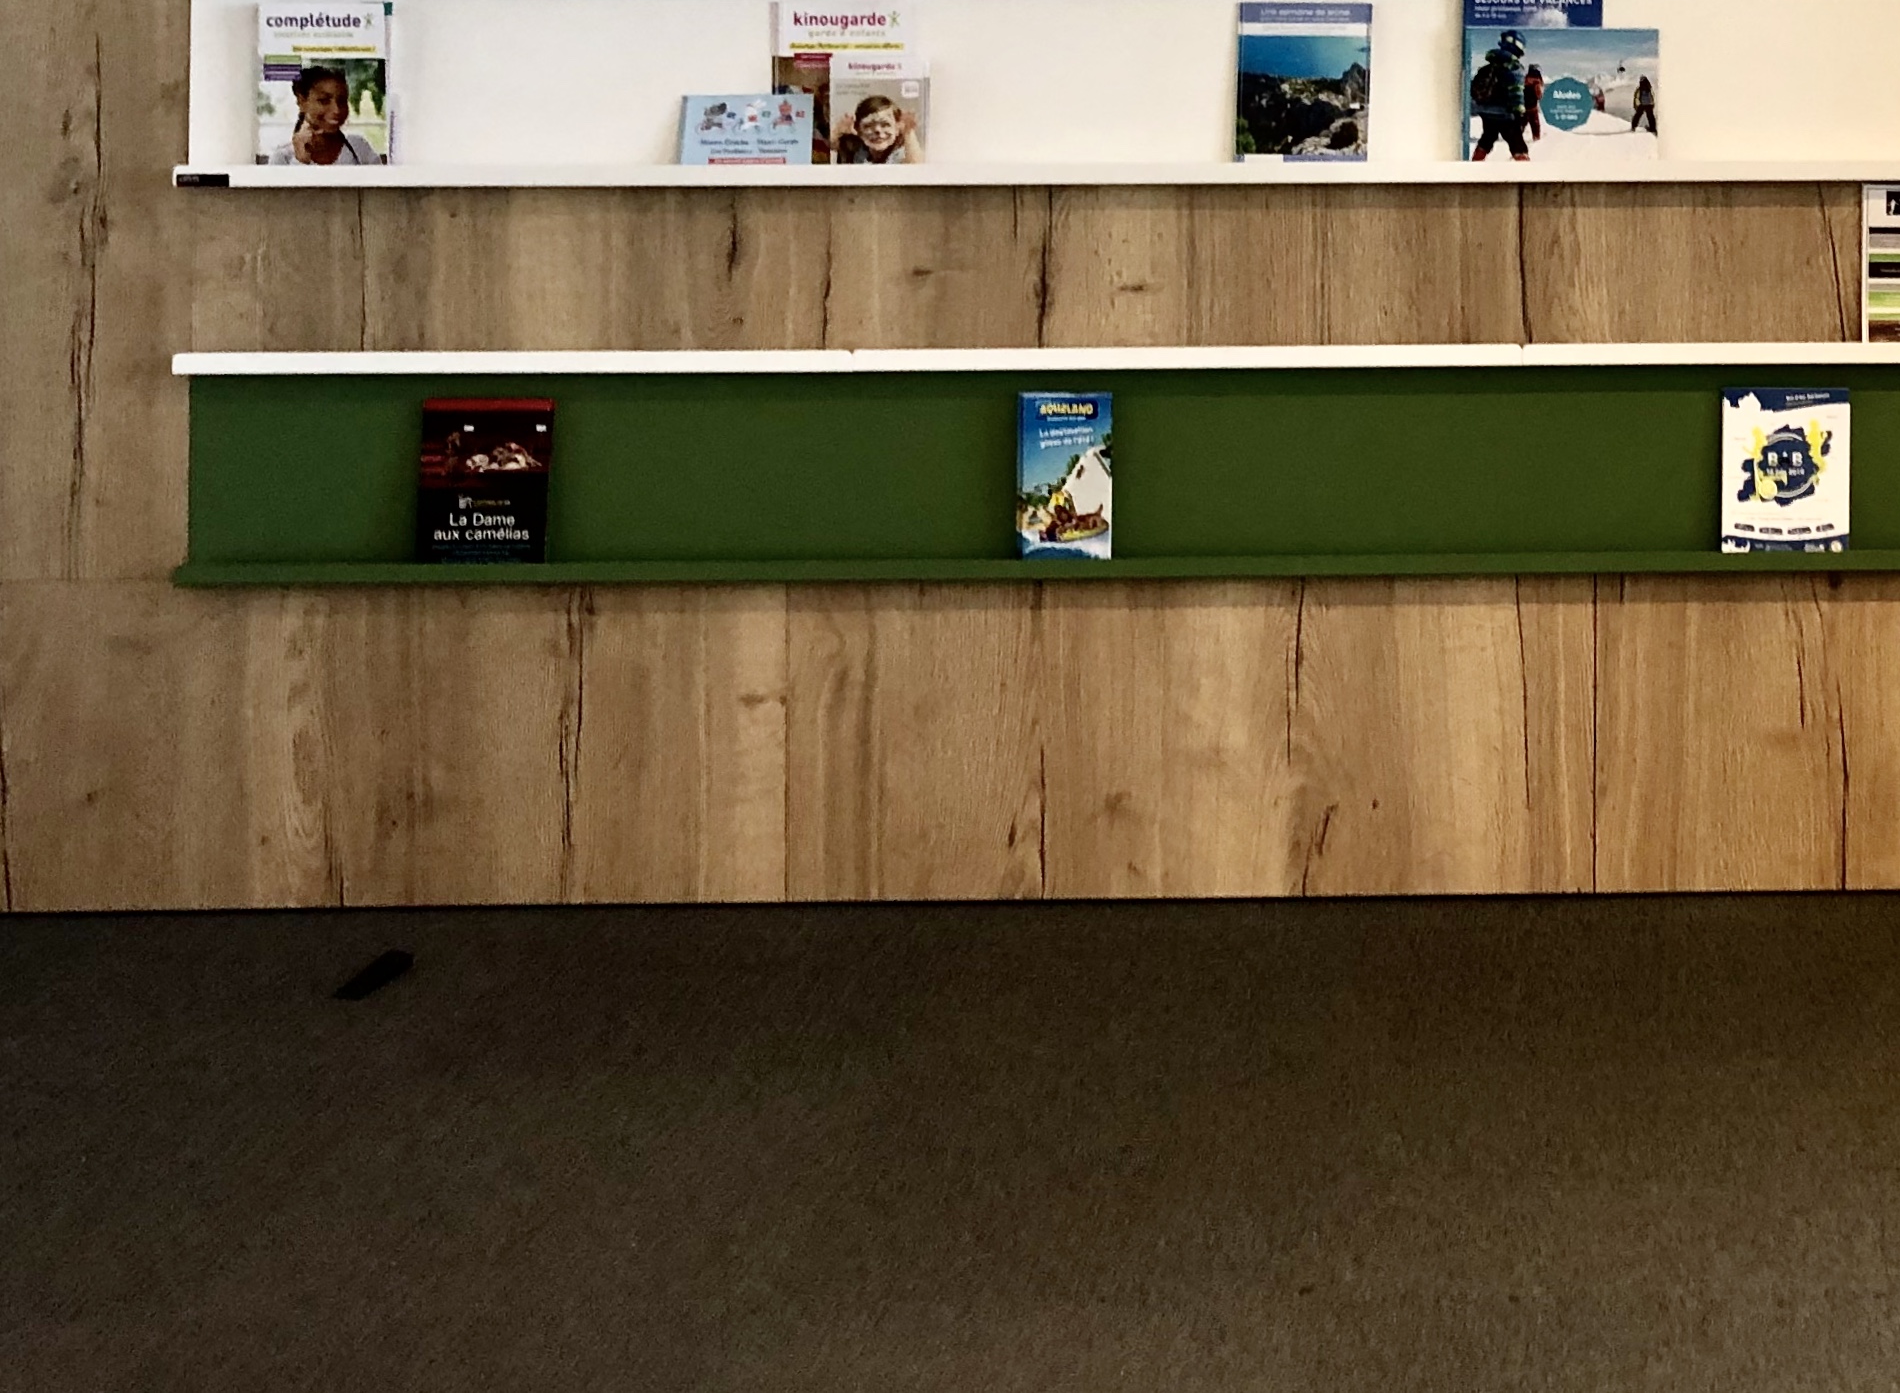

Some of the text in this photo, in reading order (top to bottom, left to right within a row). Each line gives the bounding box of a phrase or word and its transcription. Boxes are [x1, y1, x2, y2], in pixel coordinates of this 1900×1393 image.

[266, 12, 361, 30] complétude
[793, 11, 887, 29] kinougarde
[1040, 402, 1094, 415] AQUALAND
[449, 512, 516, 527] La Dame
[433, 526, 530, 541] aux camélias
